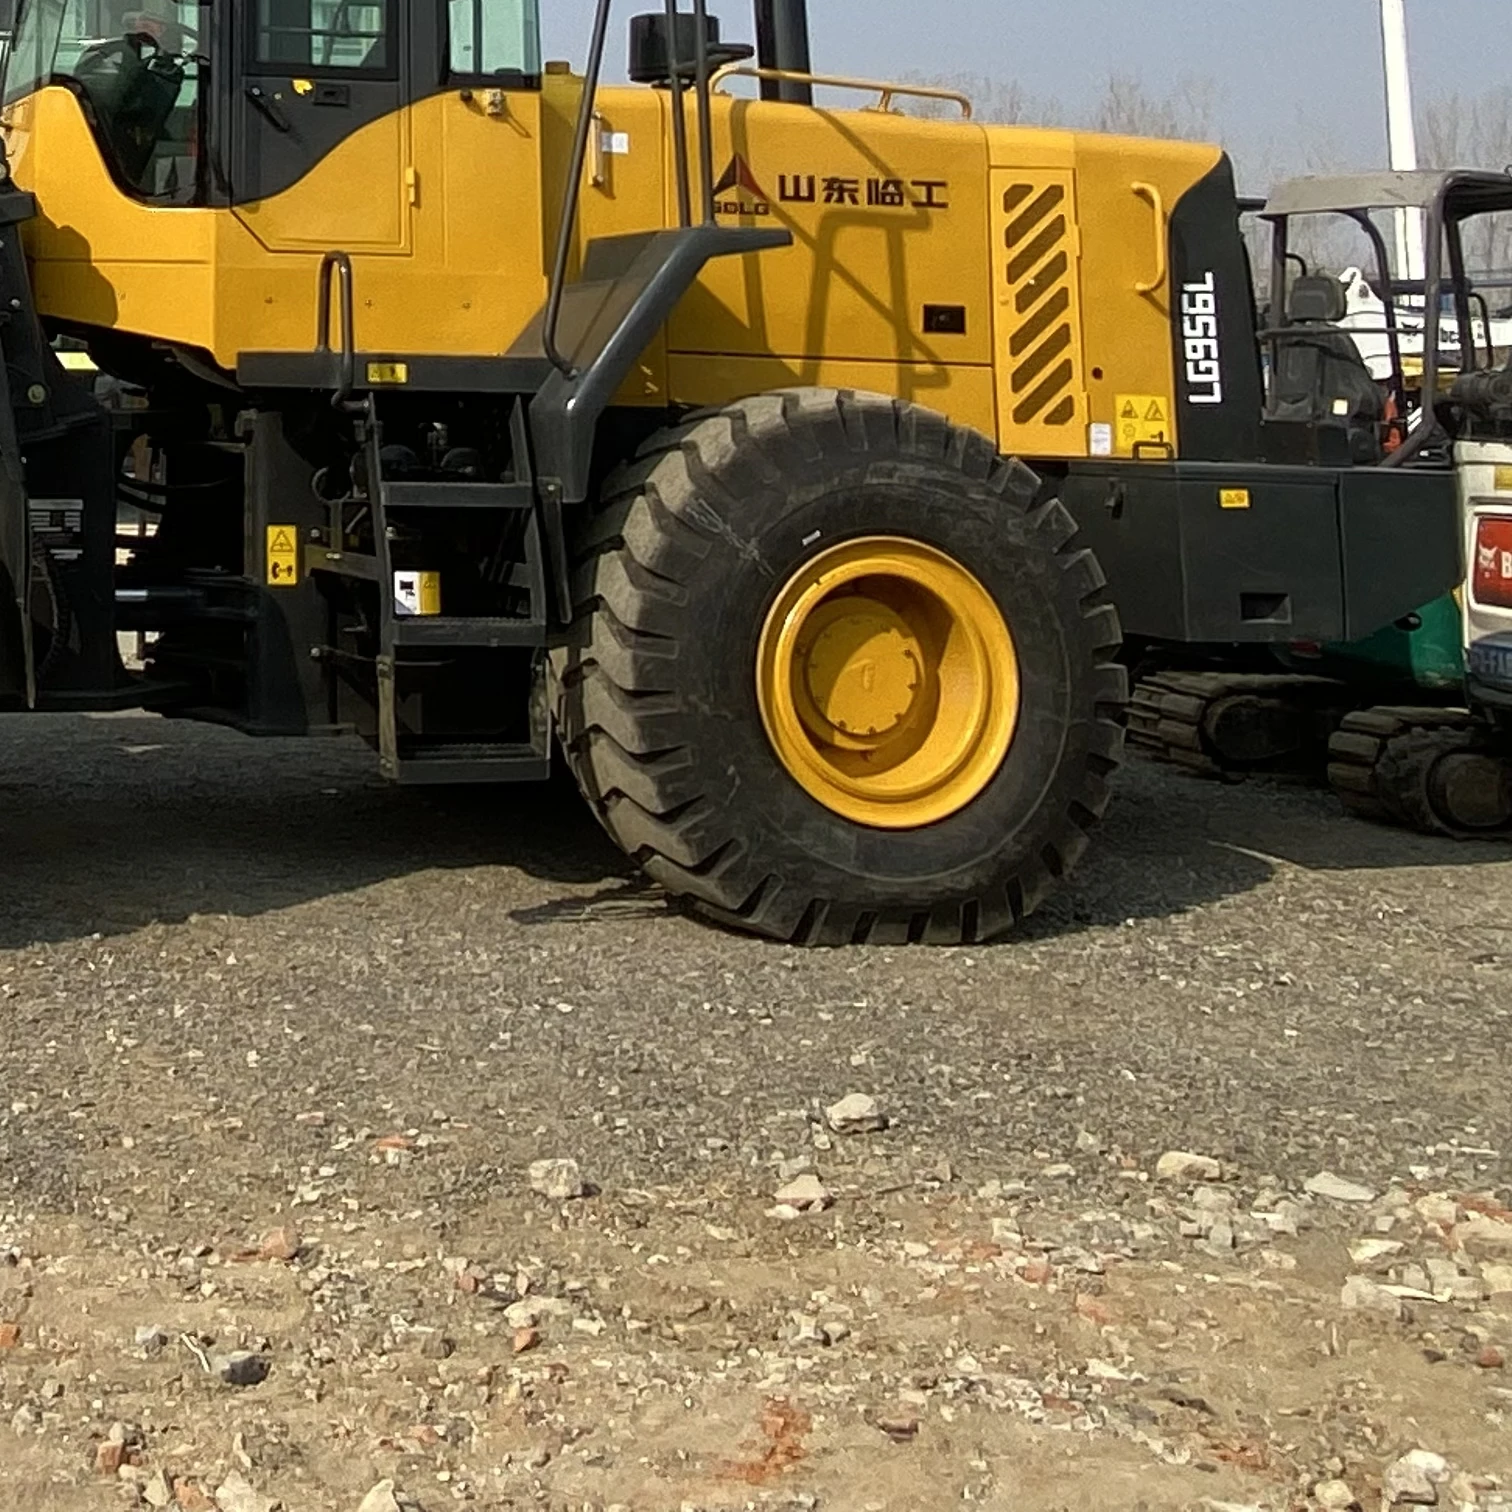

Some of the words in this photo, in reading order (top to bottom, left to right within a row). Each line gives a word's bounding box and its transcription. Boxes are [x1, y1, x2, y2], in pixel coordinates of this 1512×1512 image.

[778, 174, 949, 209] 山东临工
[1181, 271, 1222, 404] LG956L
